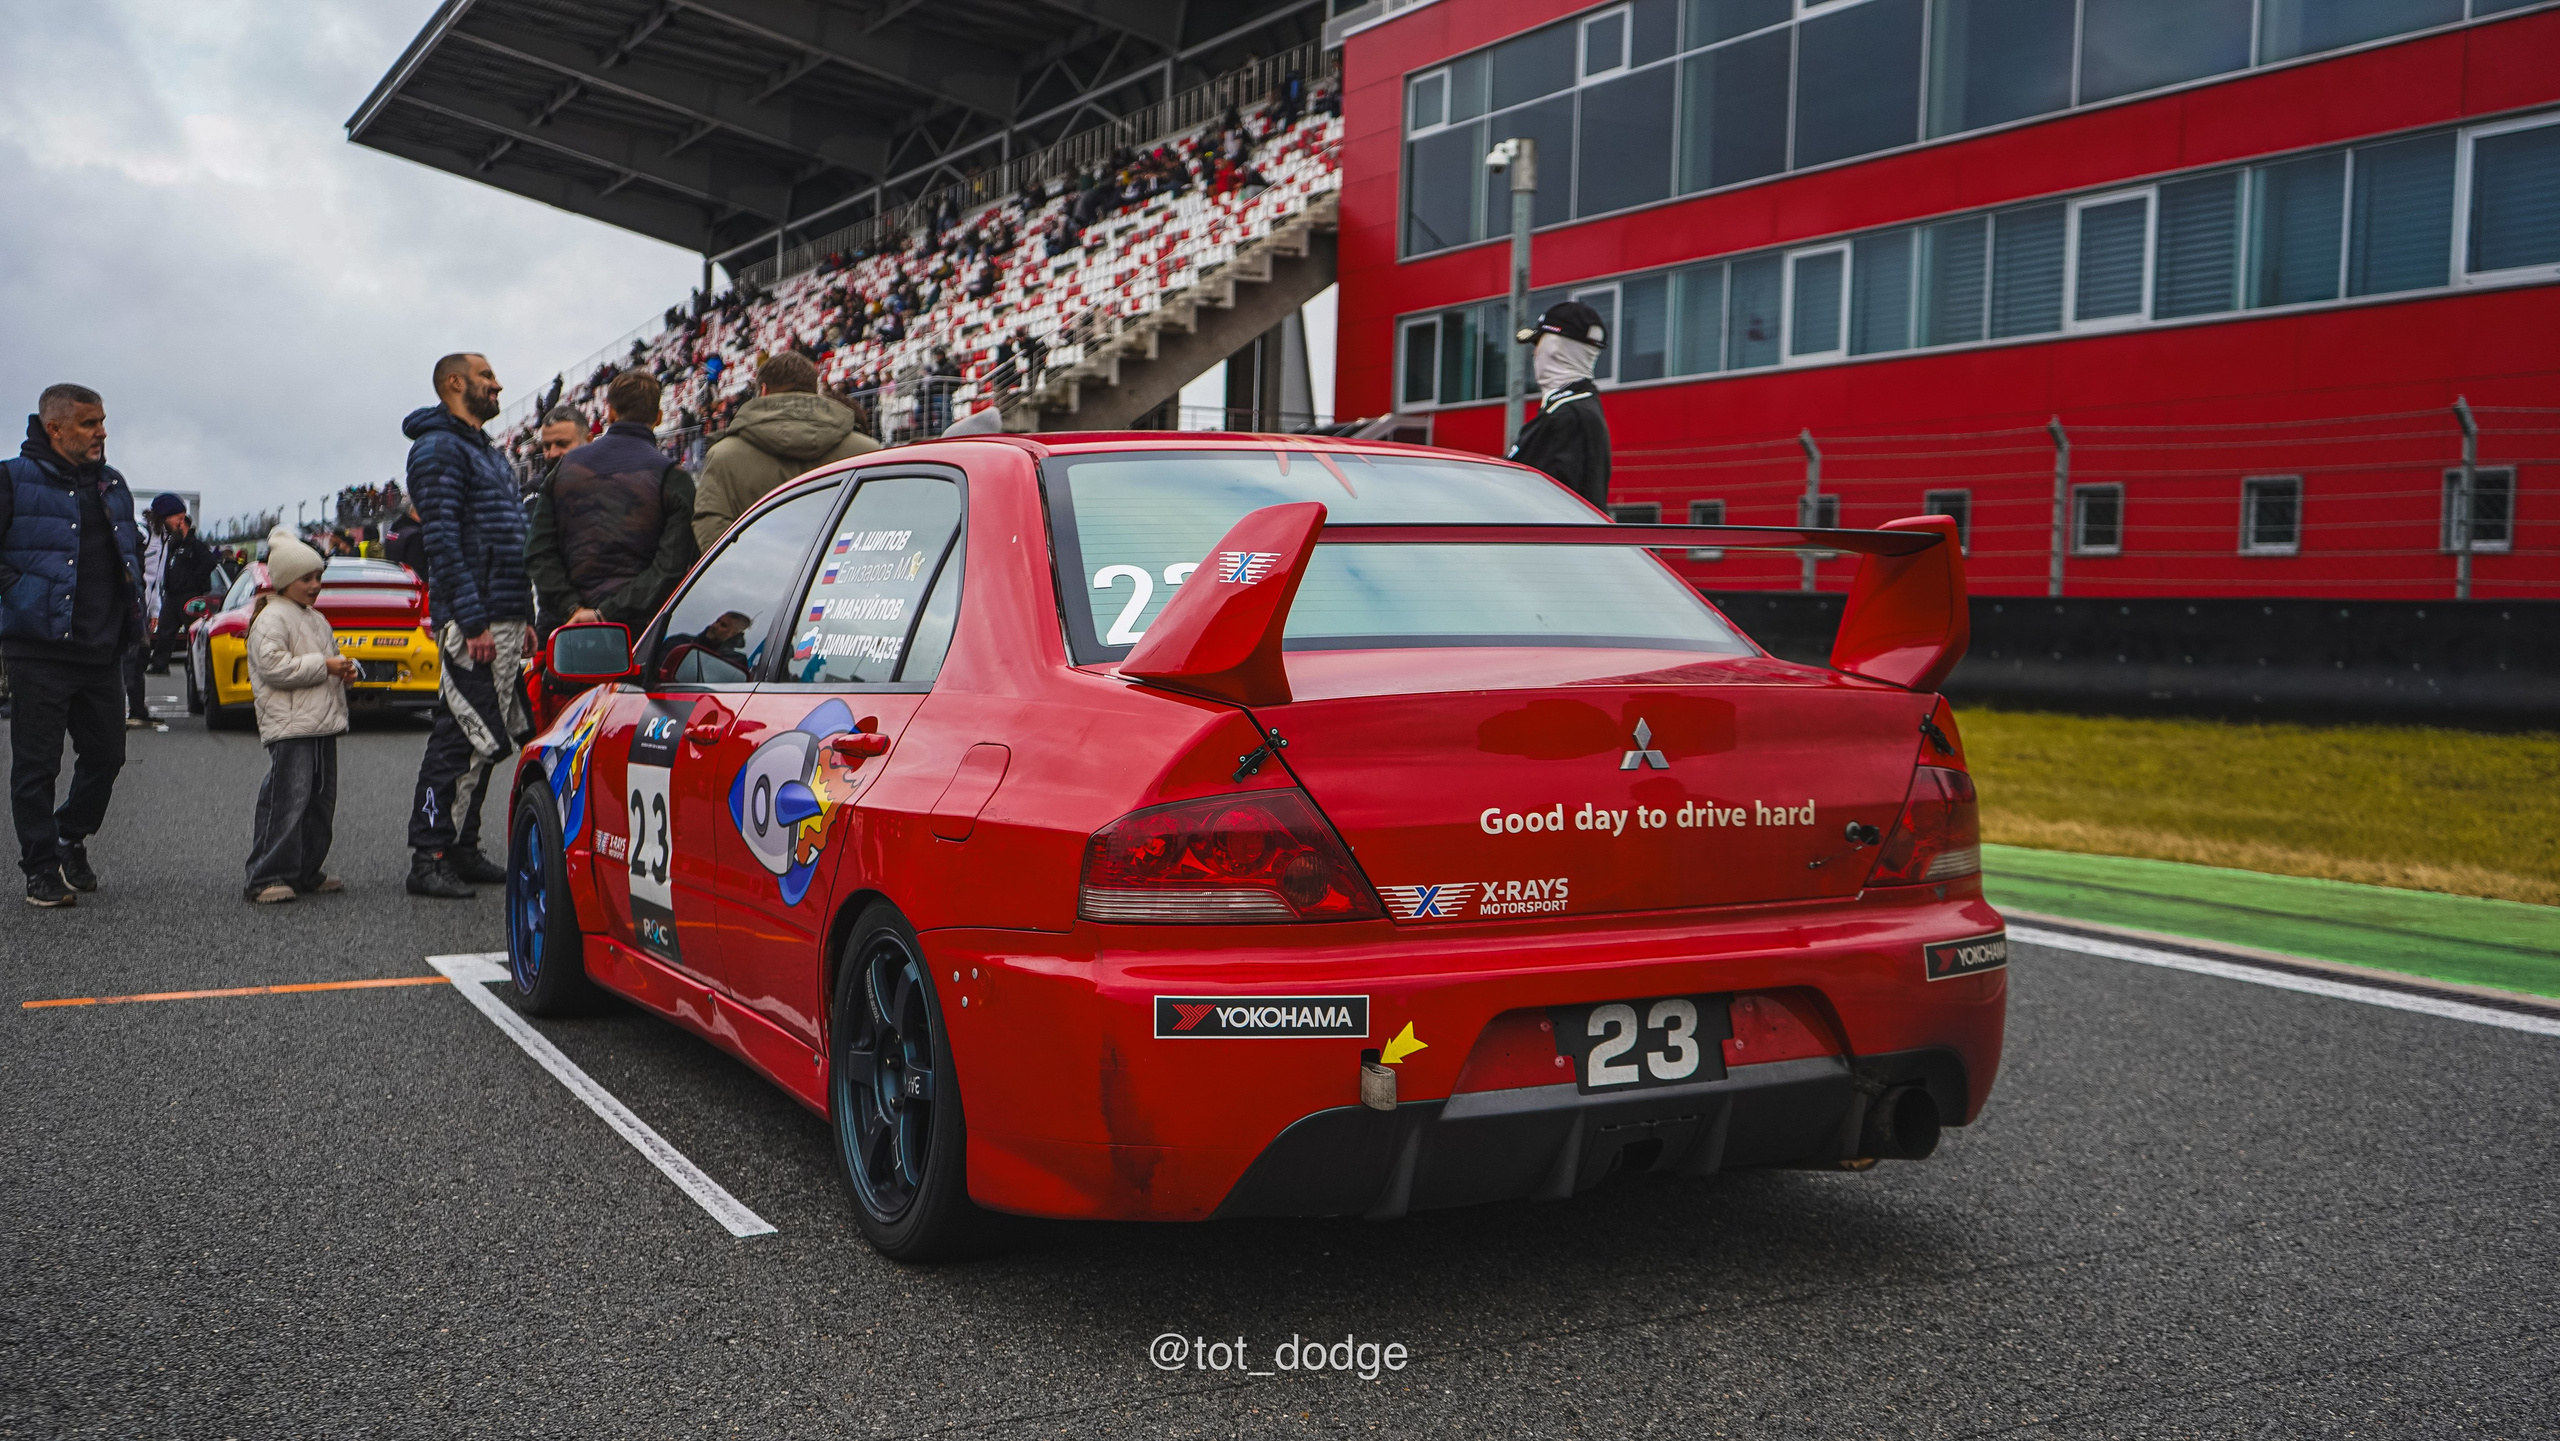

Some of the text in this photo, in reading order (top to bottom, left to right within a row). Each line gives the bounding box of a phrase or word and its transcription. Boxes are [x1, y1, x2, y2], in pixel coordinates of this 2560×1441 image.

[850, 530, 912, 551] А.ШИПОВ
[837, 561, 893, 587] Елизаров
[822, 593, 905, 621] Р.МАНУЙЛОВ
[1093, 563, 1200, 646] 2
[1479, 798, 1816, 837] Good day to drive hard
[631, 788, 668, 885] 23
[1481, 877, 1569, 903] X-RAYS
[1480, 899, 1568, 916] MOTORSPORT
[1215, 1006, 1353, 1028] YOKOHAMA
[1587, 999, 1700, 1087] 23
